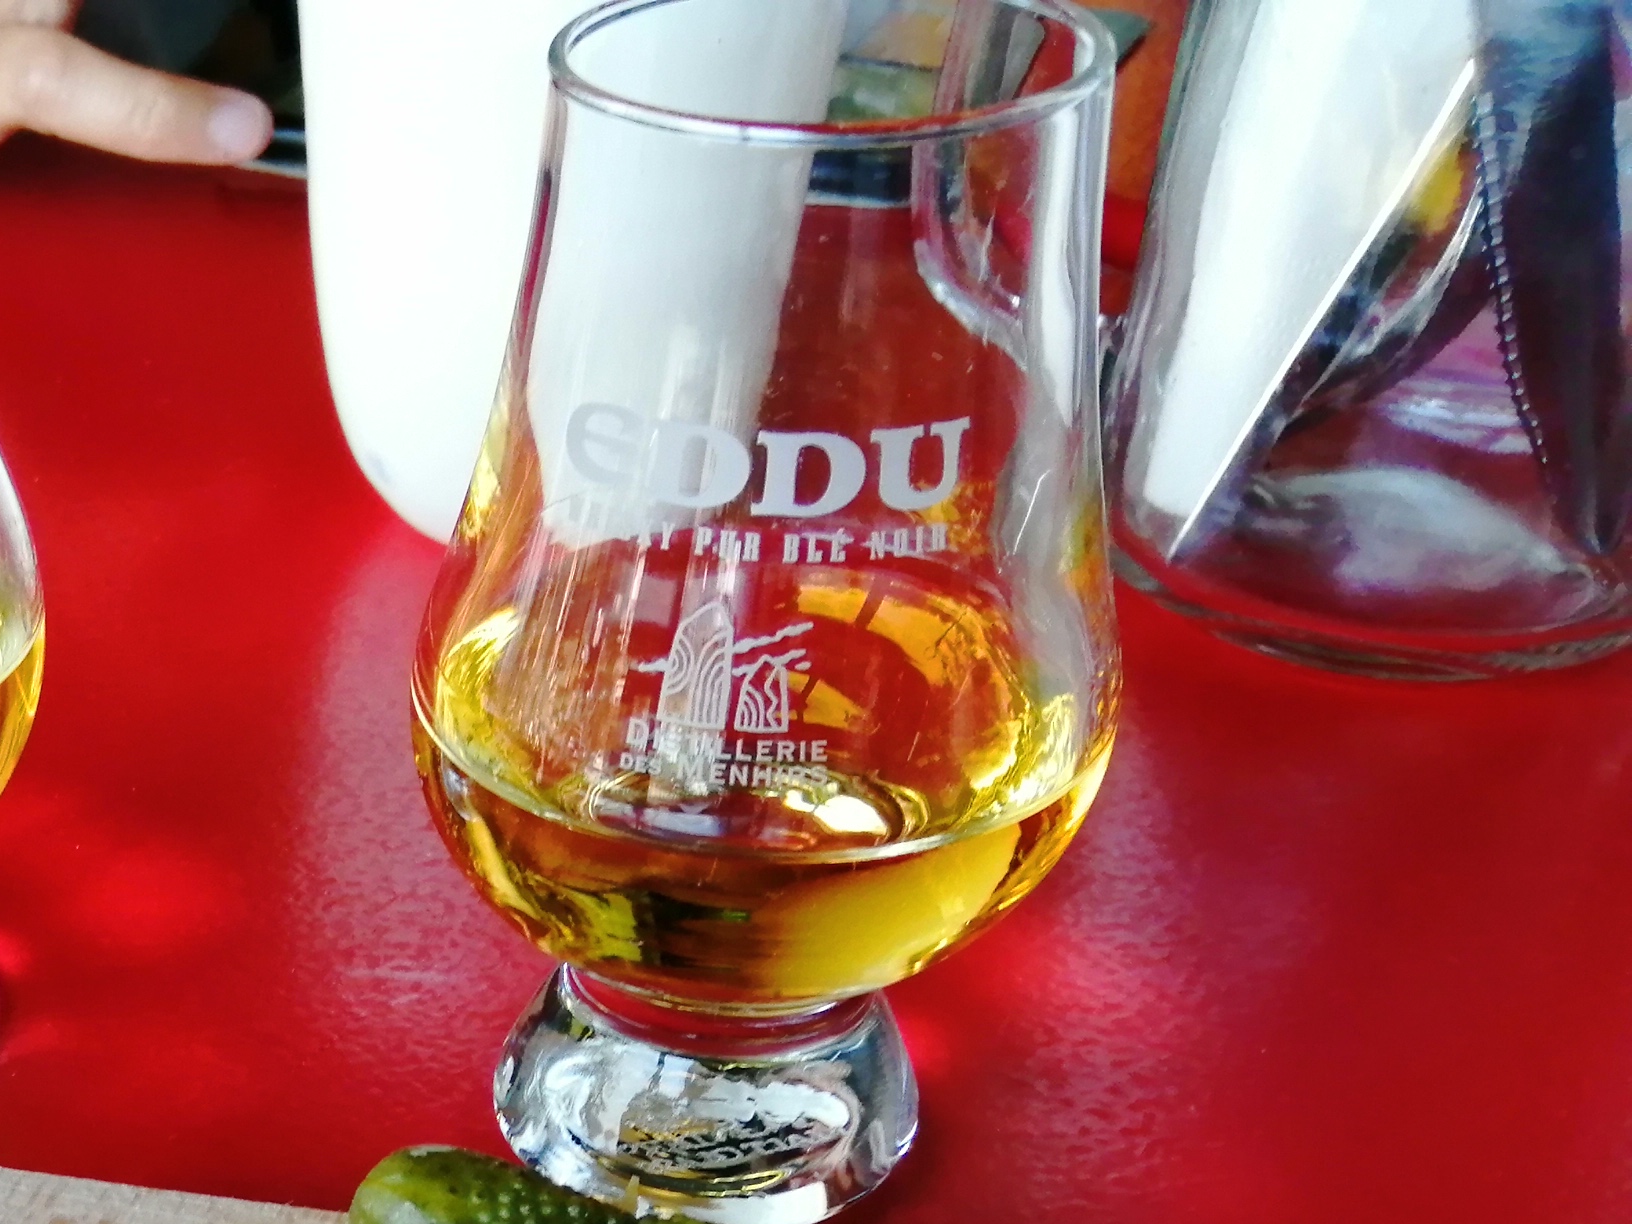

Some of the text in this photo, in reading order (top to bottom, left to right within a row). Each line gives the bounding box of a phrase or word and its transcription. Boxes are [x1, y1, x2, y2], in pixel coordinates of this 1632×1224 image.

[693, 525, 761, 562] PUR
[869, 523, 949, 561] NOIR
[619, 752, 663, 775] DES
